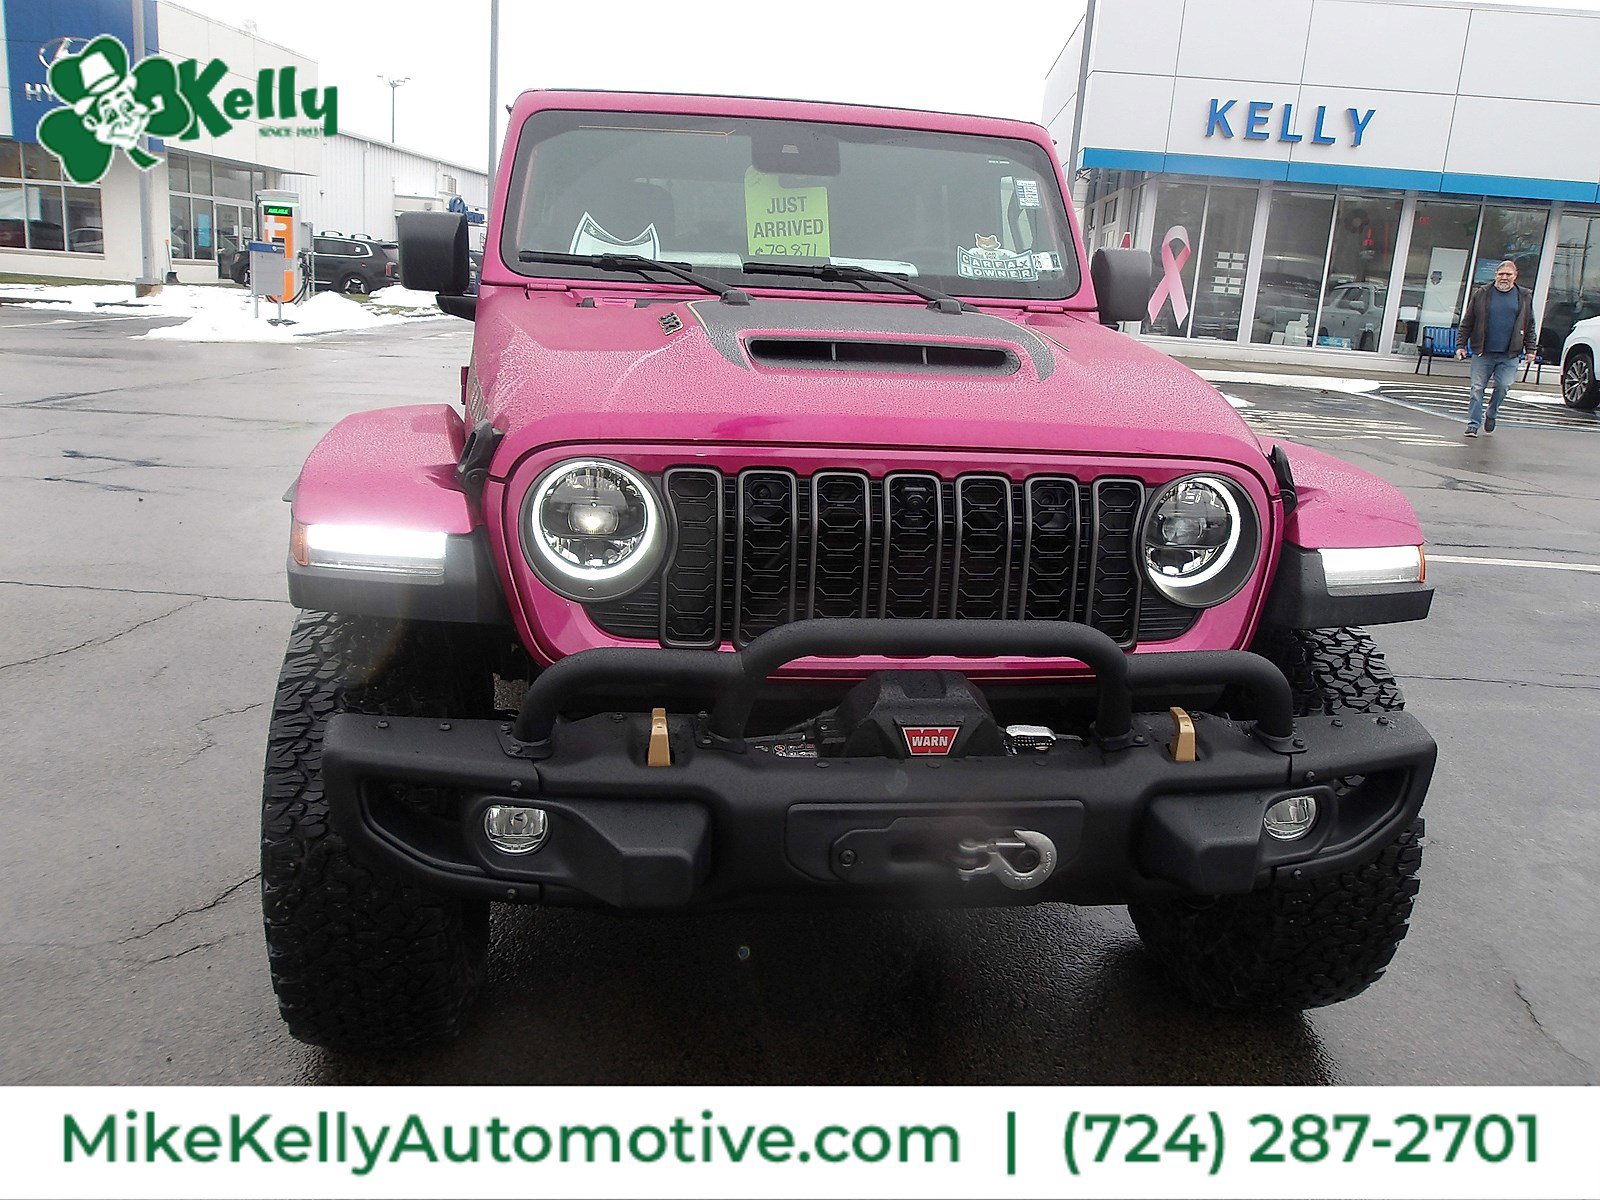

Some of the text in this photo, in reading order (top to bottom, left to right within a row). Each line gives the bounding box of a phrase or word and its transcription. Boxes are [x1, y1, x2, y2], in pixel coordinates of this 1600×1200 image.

[1205, 98, 1377, 147] KELLY
[767, 196, 808, 214] JUST
[753, 218, 824, 239] ARRIVED
[962, 254, 1028, 268] CARFAX
[973, 268, 1032, 278] OWNER
[911, 736, 949, 747] WARN
